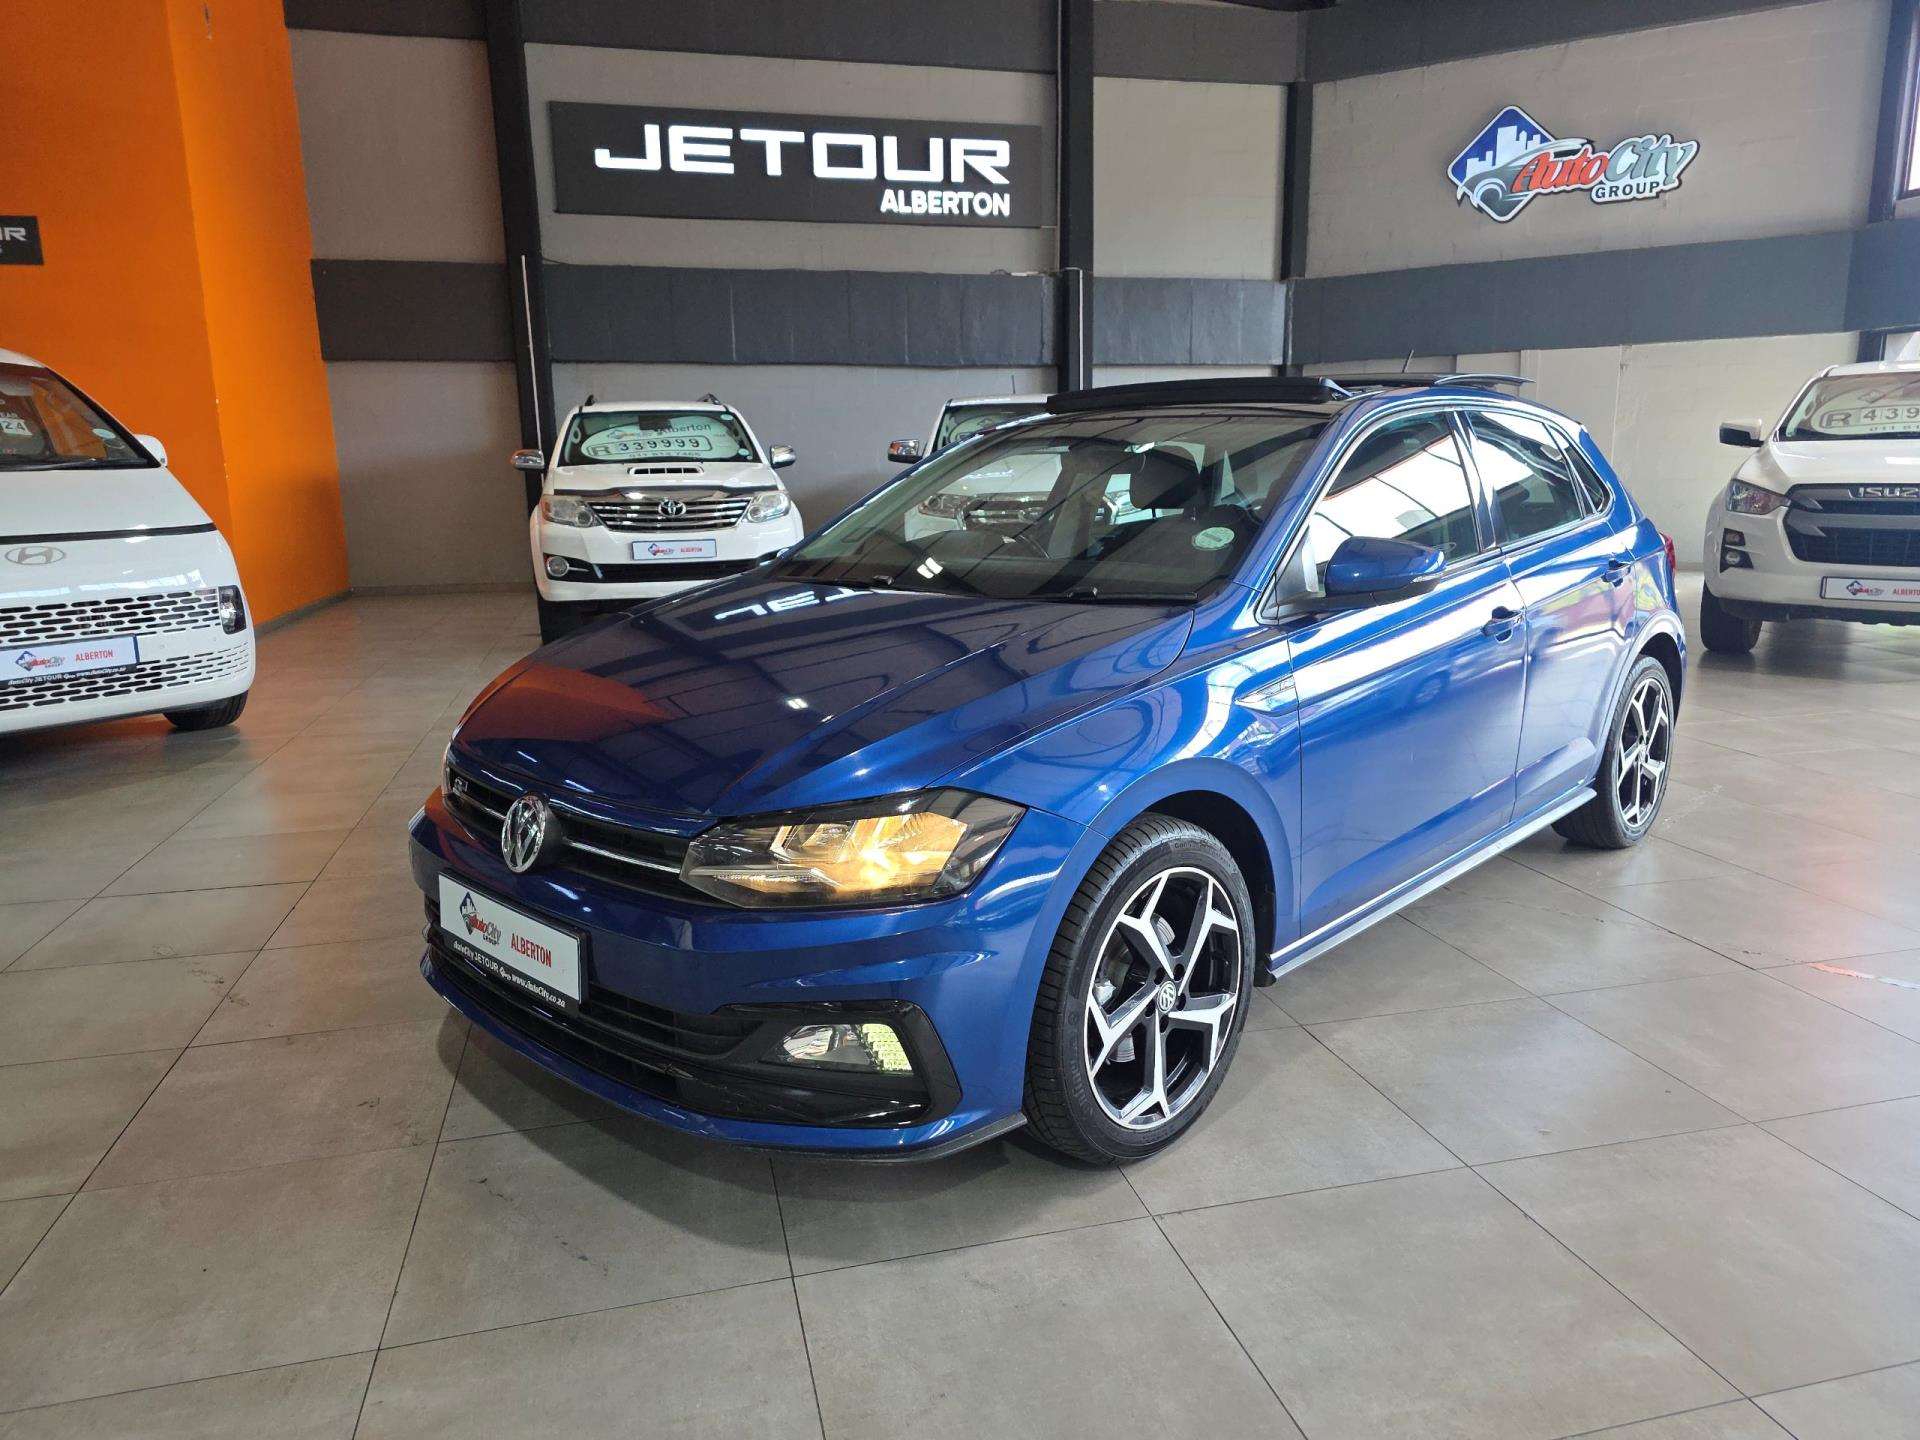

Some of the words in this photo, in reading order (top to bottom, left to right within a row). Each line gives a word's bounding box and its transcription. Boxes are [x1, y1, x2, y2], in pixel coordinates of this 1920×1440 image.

[594, 123, 1011, 185] JETOUR
[1512, 138, 1693, 193] AutoCity
[880, 188, 1011, 216] ALBERTON
[1595, 181, 1660, 199] GROUP
[619, 438, 700, 451] 339999
[75, 650, 113, 662] ALBERTON
[474, 951, 499, 973] JETOUR
[511, 933, 552, 968] ALBERTON
